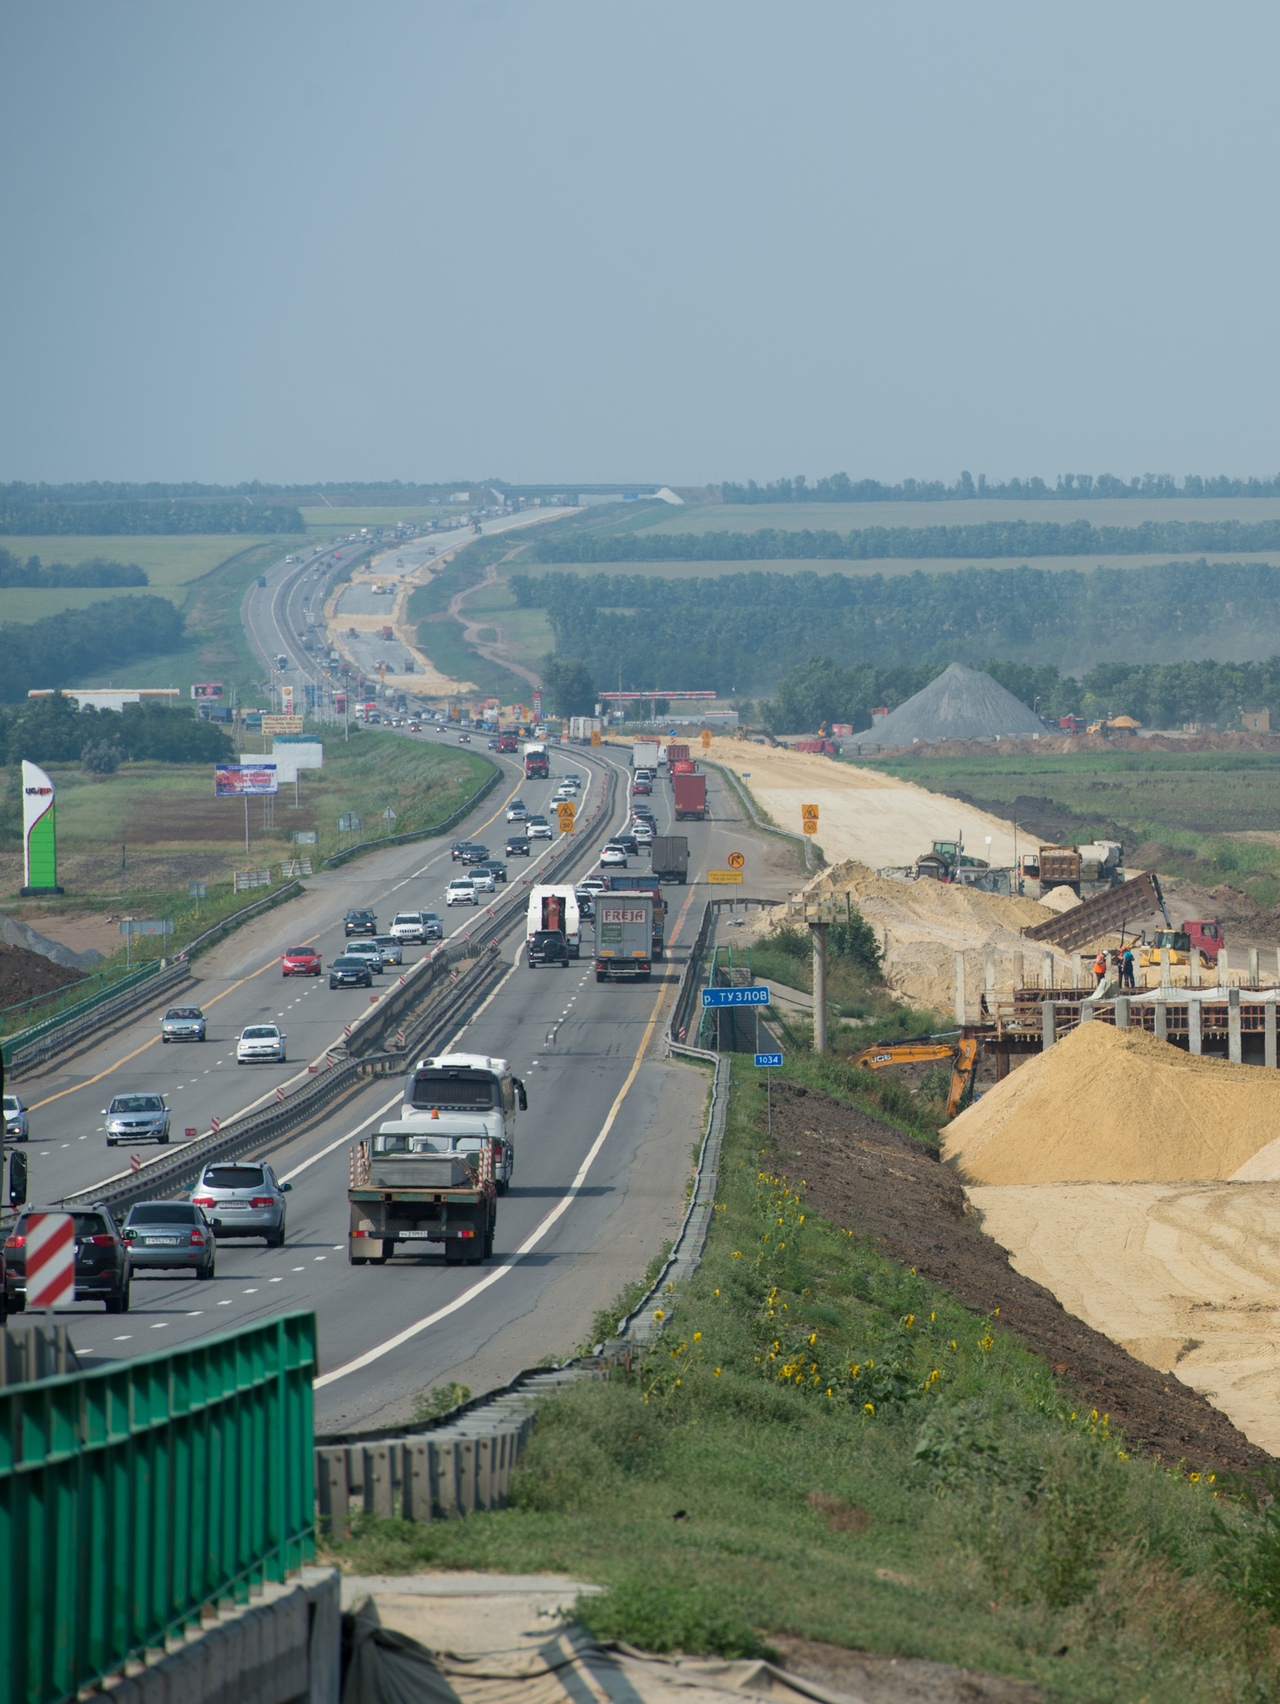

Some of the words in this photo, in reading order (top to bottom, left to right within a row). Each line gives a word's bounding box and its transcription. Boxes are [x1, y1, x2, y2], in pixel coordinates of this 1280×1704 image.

[604, 911, 643, 921] FREJA
[704, 995, 715, 1005] р.
[719, 991, 767, 1002] ТУЗЛОВ
[759, 1056, 779, 1064] 1034
[871, 1054, 892, 1063] JCB
